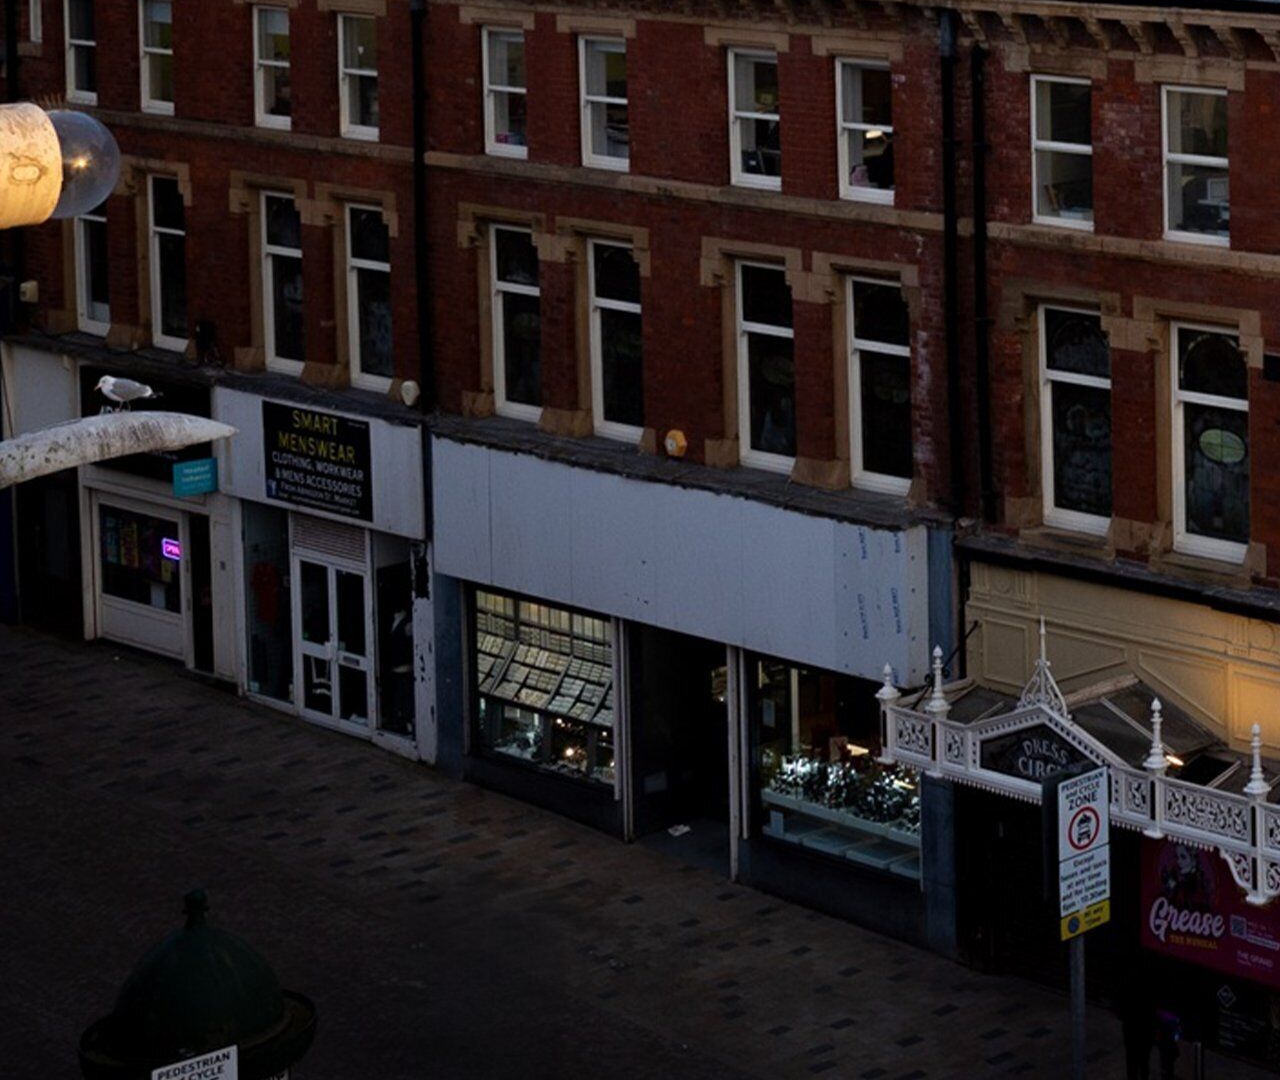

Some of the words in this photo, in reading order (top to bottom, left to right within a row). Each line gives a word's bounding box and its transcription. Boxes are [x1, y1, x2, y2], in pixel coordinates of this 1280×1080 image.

[291, 409, 338, 436] SMART
[276, 430, 356, 465] MENSWEAR
[315, 461, 364, 482] WORKWEAR
[306, 475, 363, 499] ACCESSORIES
[1022, 739, 1069, 765] DRESS
[1018, 756, 1062, 778] CIRC
[1061, 771, 1104, 792] PEDESTRIAN
[1079, 781, 1100, 795] CYCLE
[1068, 791, 1098, 811] ZONE
[1149, 896, 1225, 943] Grease
[158, 1051, 230, 1079] PEDESTRIAN
